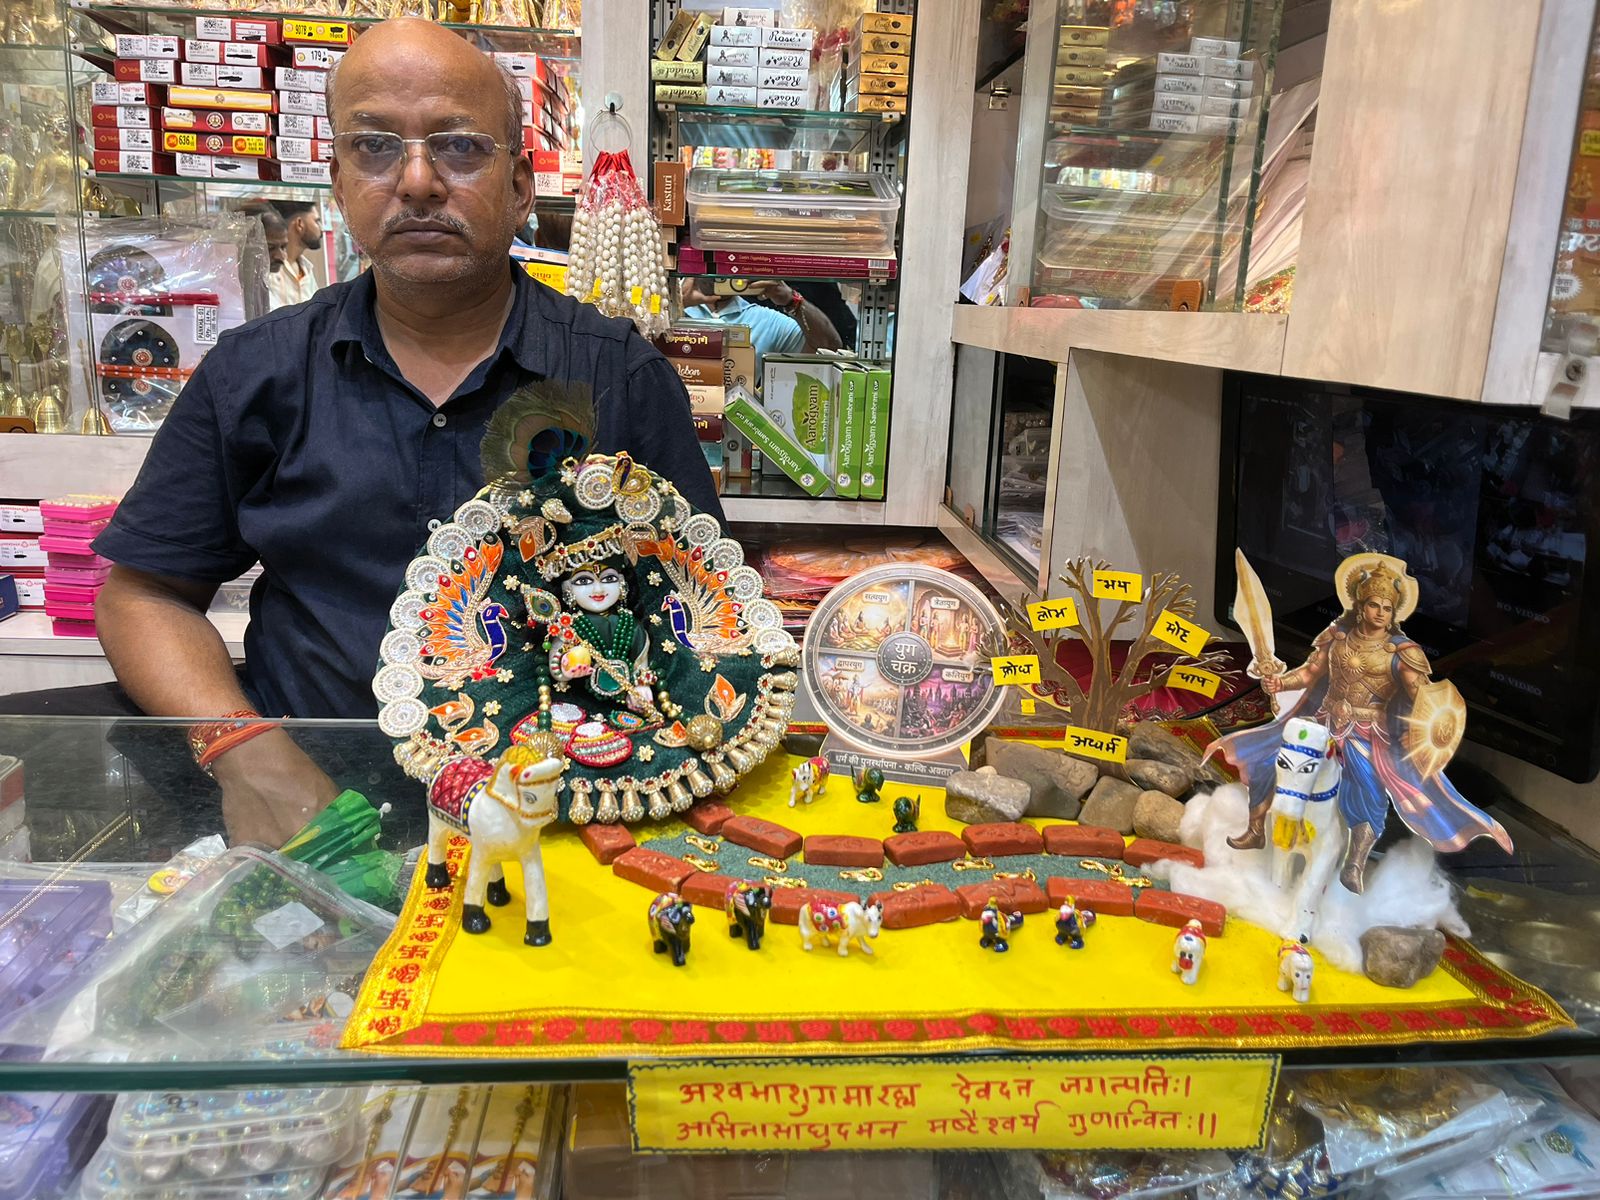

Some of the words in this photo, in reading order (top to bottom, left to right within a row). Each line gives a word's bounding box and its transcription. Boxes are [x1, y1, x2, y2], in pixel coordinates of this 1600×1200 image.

[663, 175, 672, 211] Kasturi
[698, 335, 708, 345] Lal
[677, 364, 701, 377] Loban
[803, 384, 819, 448] Aarogyam
[845, 392, 854, 425] Sambrani
[869, 392, 878, 425] Sambrani
[744, 418, 770, 443] Sambrani
[768, 441, 801, 472] Aarogyam
[842, 426, 853, 468] Aarogyam
[866, 426, 877, 467] Aarogyam
[1166, 620, 1190, 643] मोह
[894, 642, 917, 659] युग
[891, 660, 918, 674] चक्र
[1176, 672, 1213, 687] पाप
[1070, 734, 1121, 754] अधर्म
[835, 754, 848, 763] धर्म
